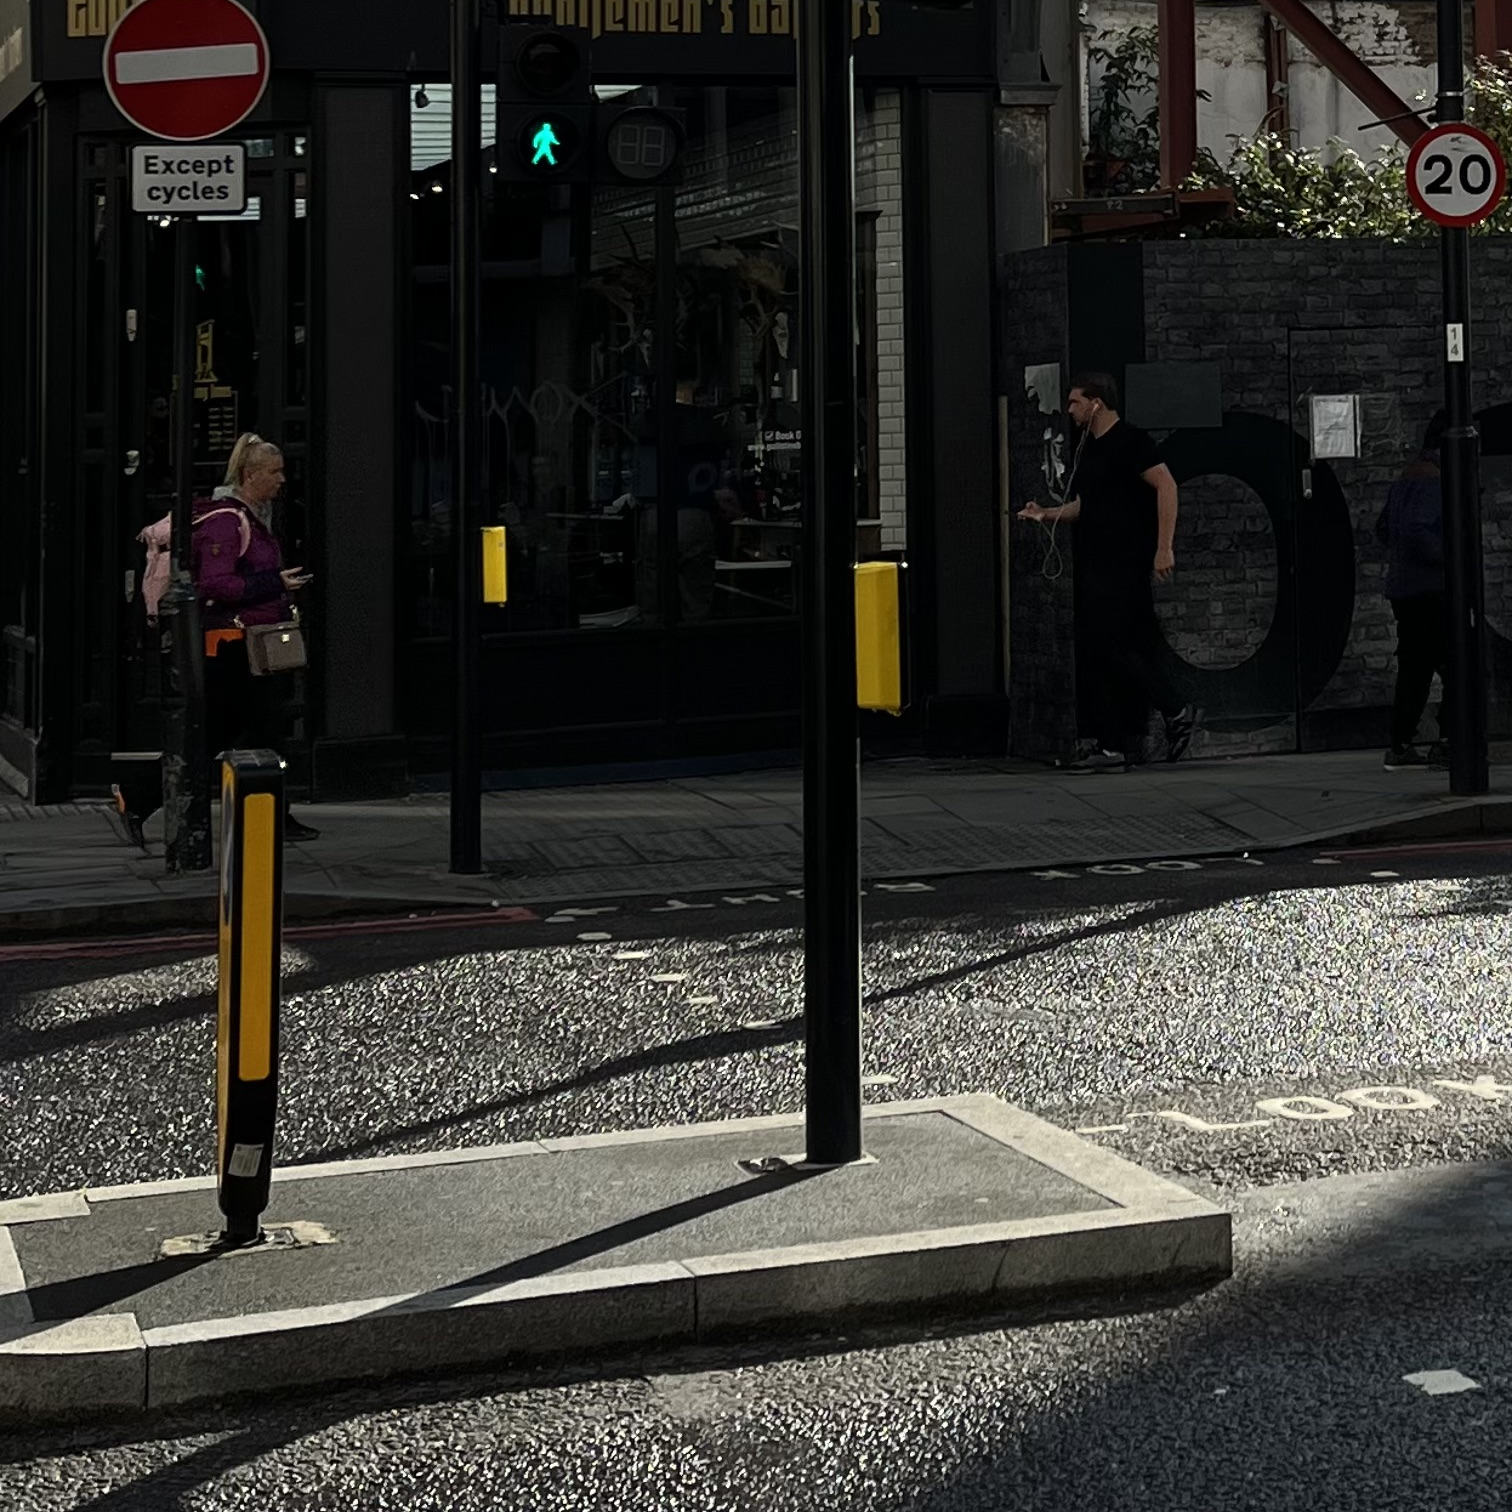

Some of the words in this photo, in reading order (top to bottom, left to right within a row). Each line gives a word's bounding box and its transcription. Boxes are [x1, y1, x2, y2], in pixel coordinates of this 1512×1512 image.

[144, 155, 235, 178] Except
[1424, 154, 1491, 194] 20
[147, 183, 229, 204] cycles
